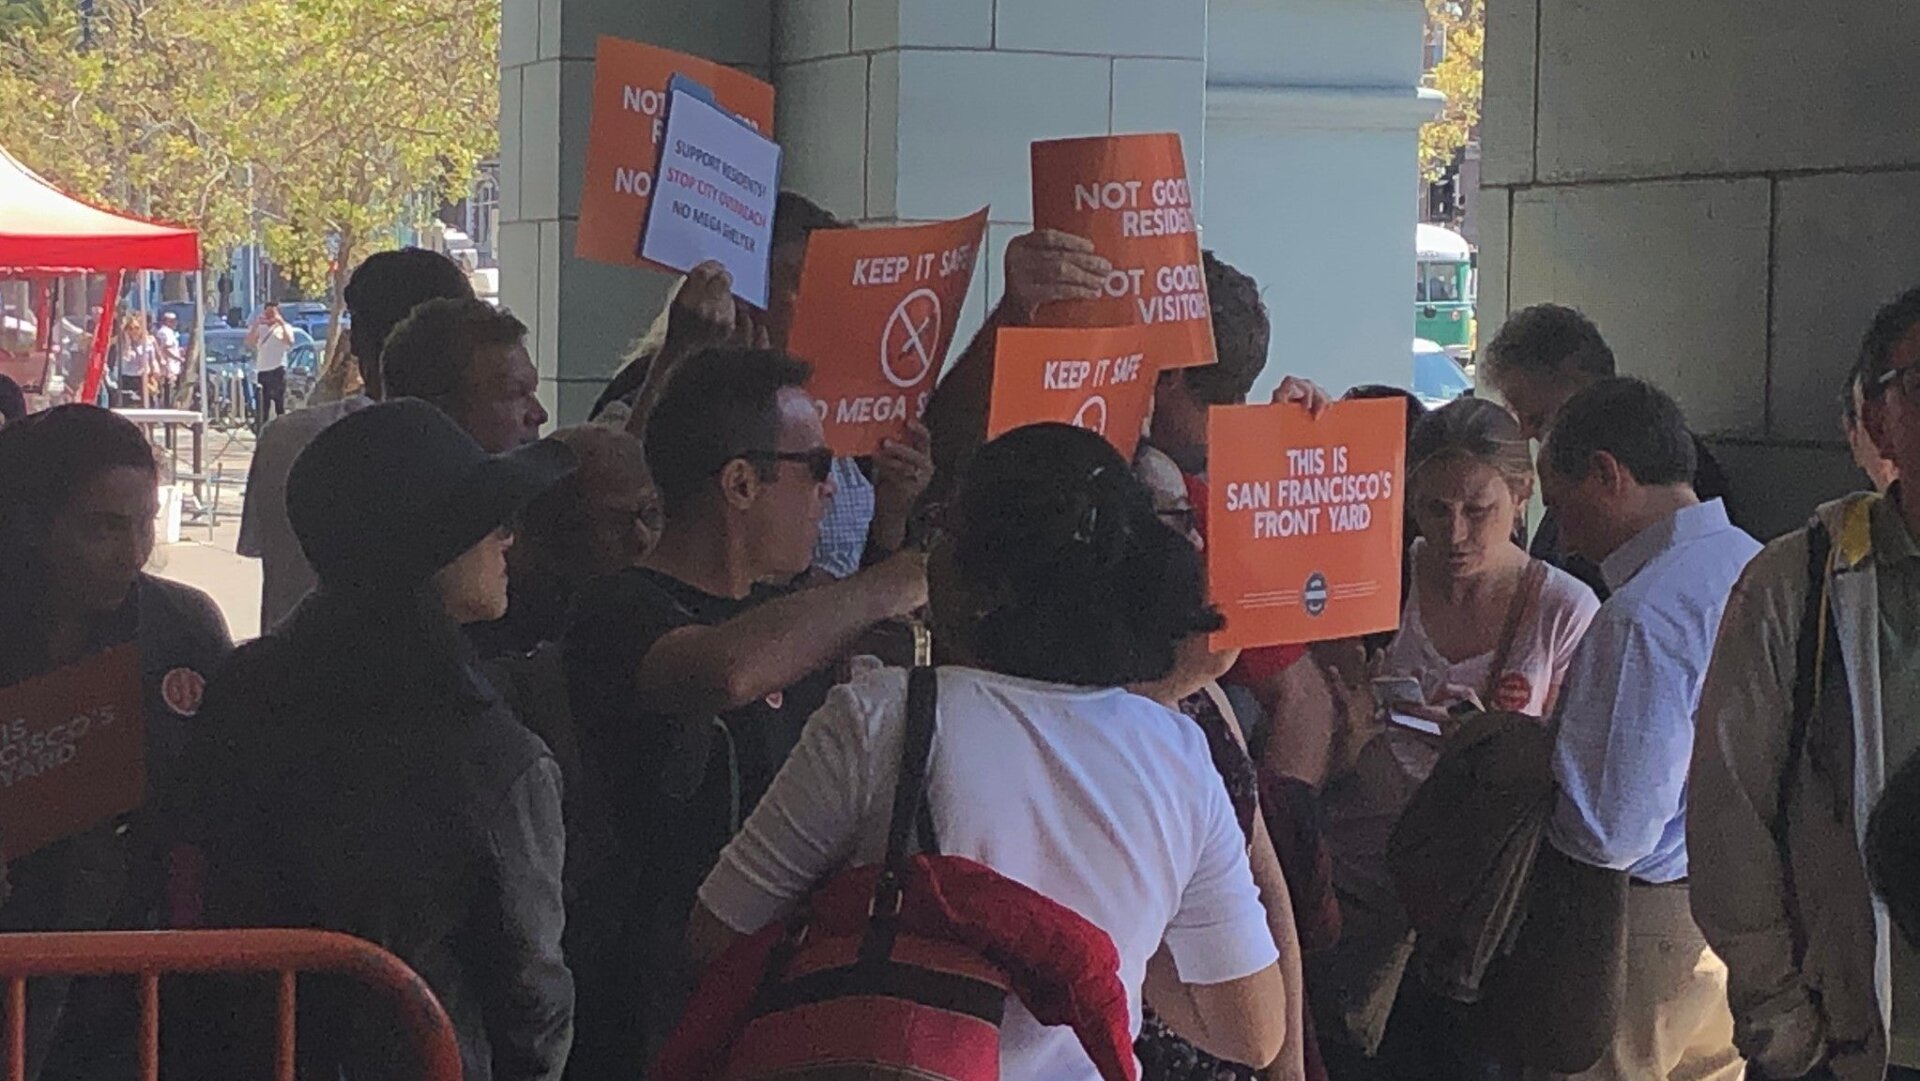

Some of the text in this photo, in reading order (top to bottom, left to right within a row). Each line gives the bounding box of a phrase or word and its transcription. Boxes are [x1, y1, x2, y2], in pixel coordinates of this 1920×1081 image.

[674, 139, 721, 173] SUPPORT
[665, 166, 768, 228] STOP CITY OUTREACH
[1074, 180, 1142, 211] NOT
[671, 200, 757, 253] NO MEGA SHELTER
[852, 255, 910, 285] KEEP
[914, 252, 936, 282] IT
[1104, 268, 1145, 297] OT
[1043, 352, 1144, 390] KEEP IT SAFE
[836, 394, 907, 424] MEGA
[1286, 445, 1348, 477] THIS IS
[1226, 470, 1392, 511] SAN FRANCISCO'S
[1254, 503, 1371, 539] FRONT YARD
